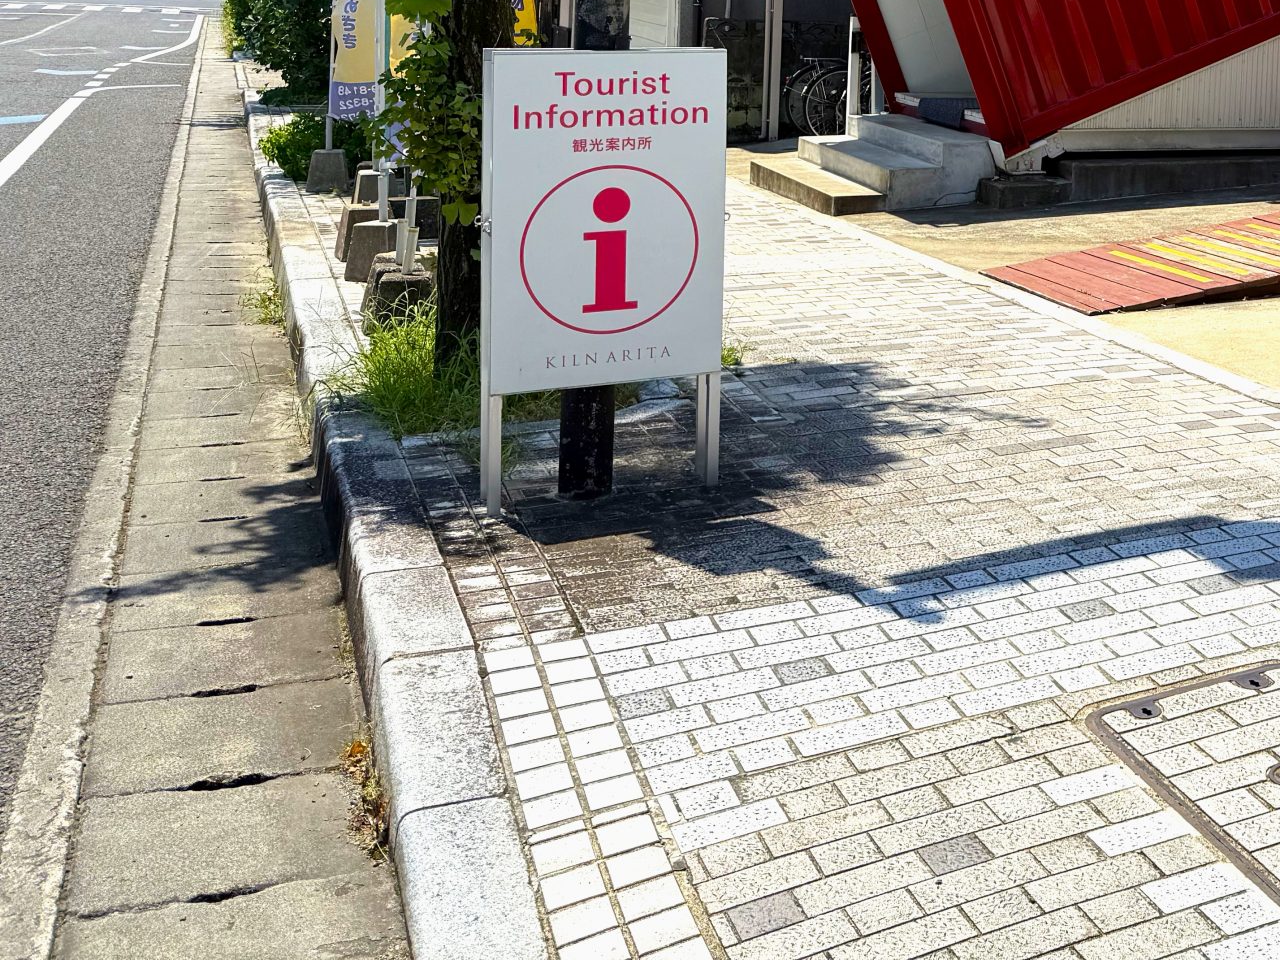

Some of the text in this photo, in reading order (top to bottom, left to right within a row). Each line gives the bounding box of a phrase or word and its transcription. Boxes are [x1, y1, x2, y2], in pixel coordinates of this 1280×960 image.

[554, 70, 671, 97] Tourist
[512, 101, 709, 130] Information
[572, 136, 653, 153] 観光案内所
[546, 346, 671, 369] KILN ARITA
